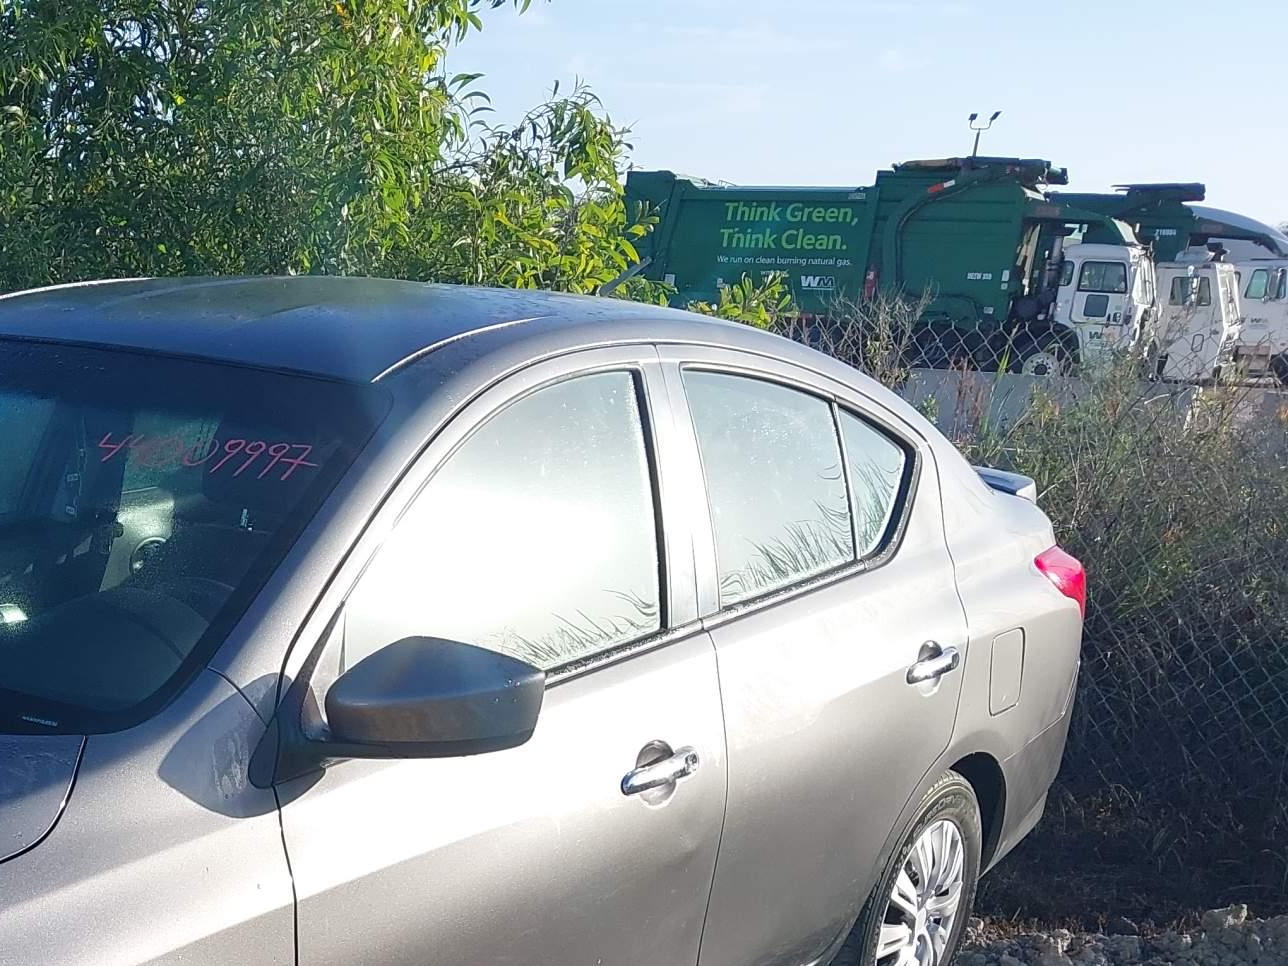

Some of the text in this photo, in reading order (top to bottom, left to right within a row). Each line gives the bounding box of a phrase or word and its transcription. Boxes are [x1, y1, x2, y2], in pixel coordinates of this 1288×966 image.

[725, 202, 858, 226] Think Green,
[720, 228, 847, 250] Think Clean.
[717, 255, 729, 263] We
[730, 256, 743, 264] run
[755, 255, 775, 264] clean
[777, 256, 807, 266] burning
[808, 256, 836, 265] natural
[800, 275, 836, 288] WM
